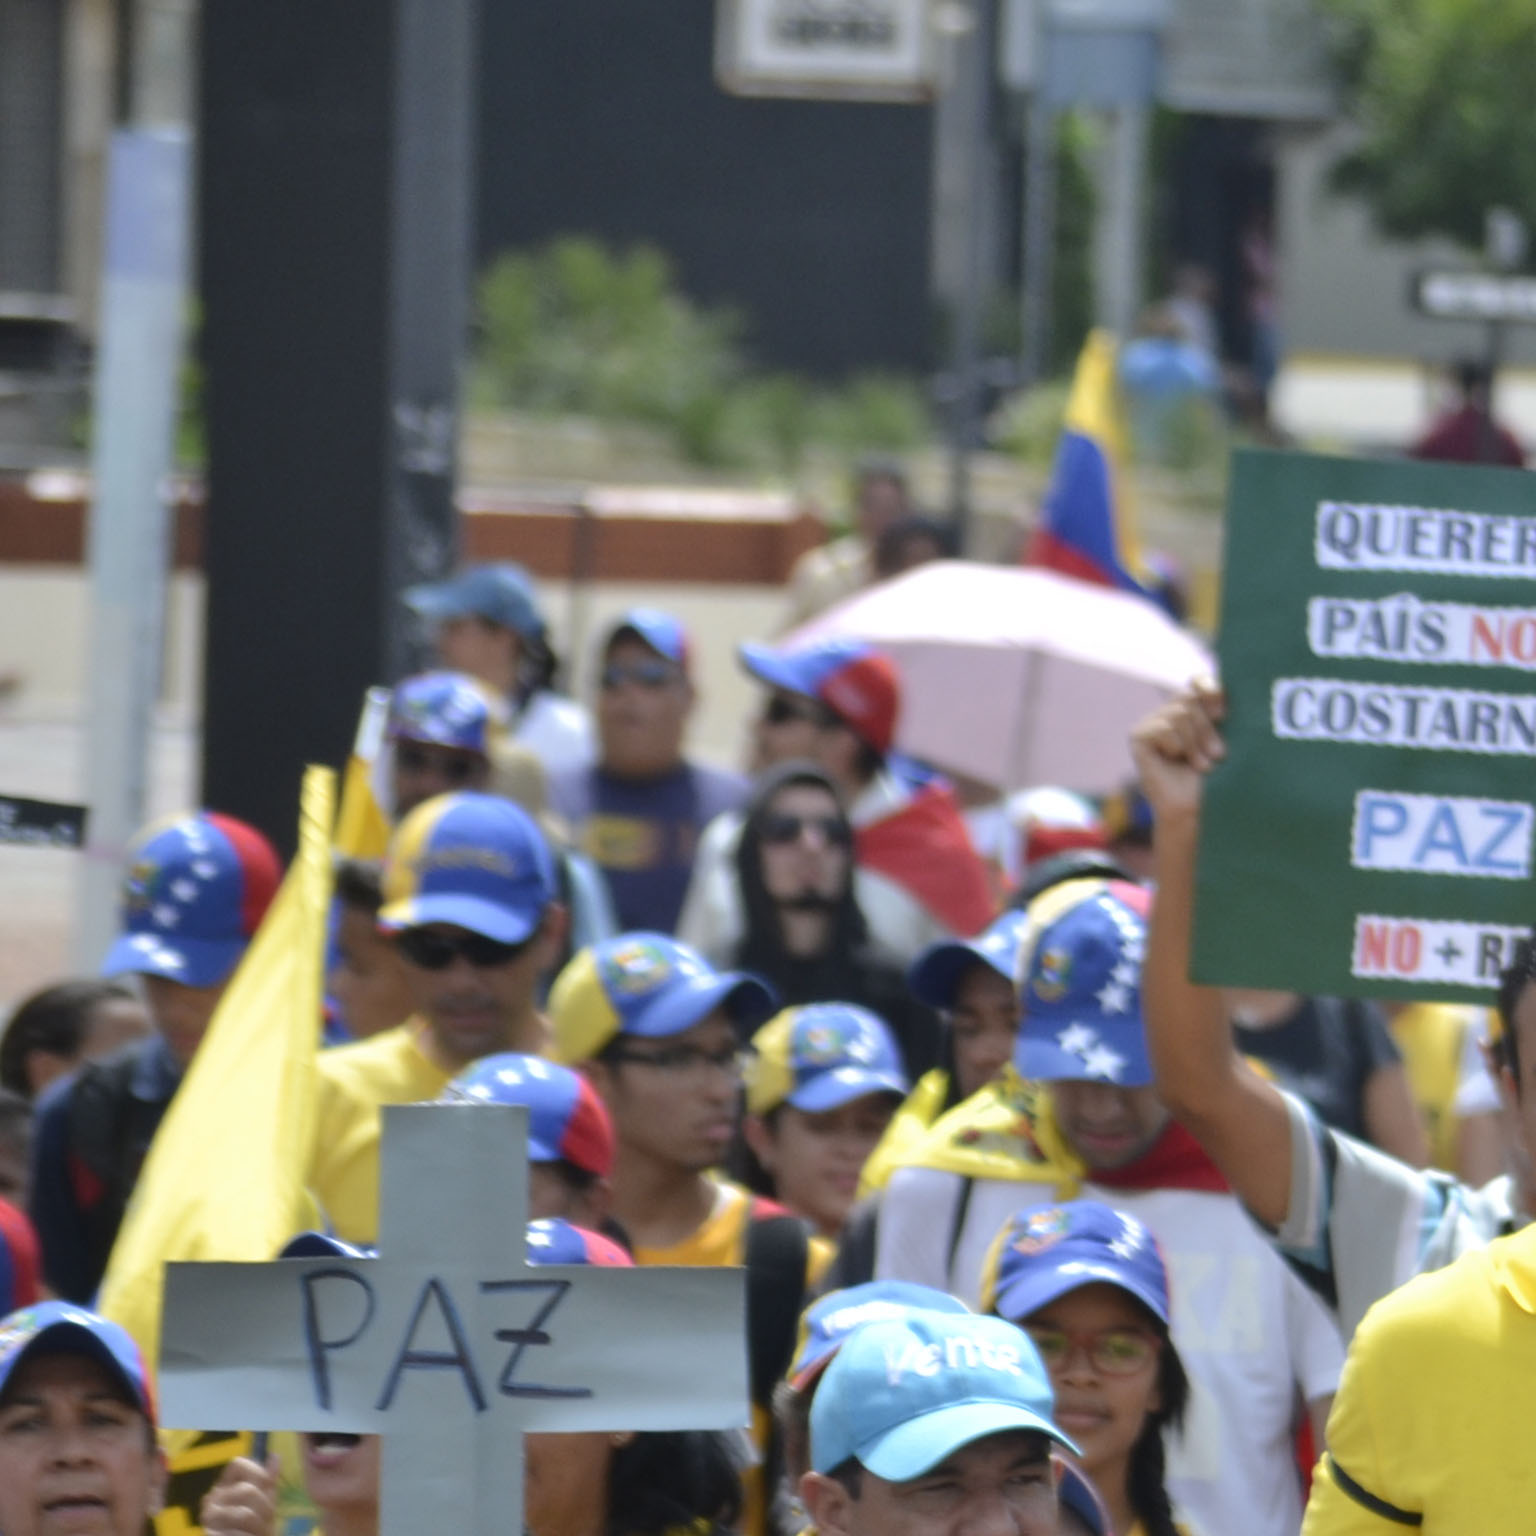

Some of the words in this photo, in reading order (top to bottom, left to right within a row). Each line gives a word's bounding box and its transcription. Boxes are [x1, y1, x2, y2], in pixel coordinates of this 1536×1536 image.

[1356, 800, 1528, 872] PAZ
[1359, 928, 1421, 974] NO
[302, 1268, 593, 1411] PAZ
[883, 1335, 1023, 1387] Vente
